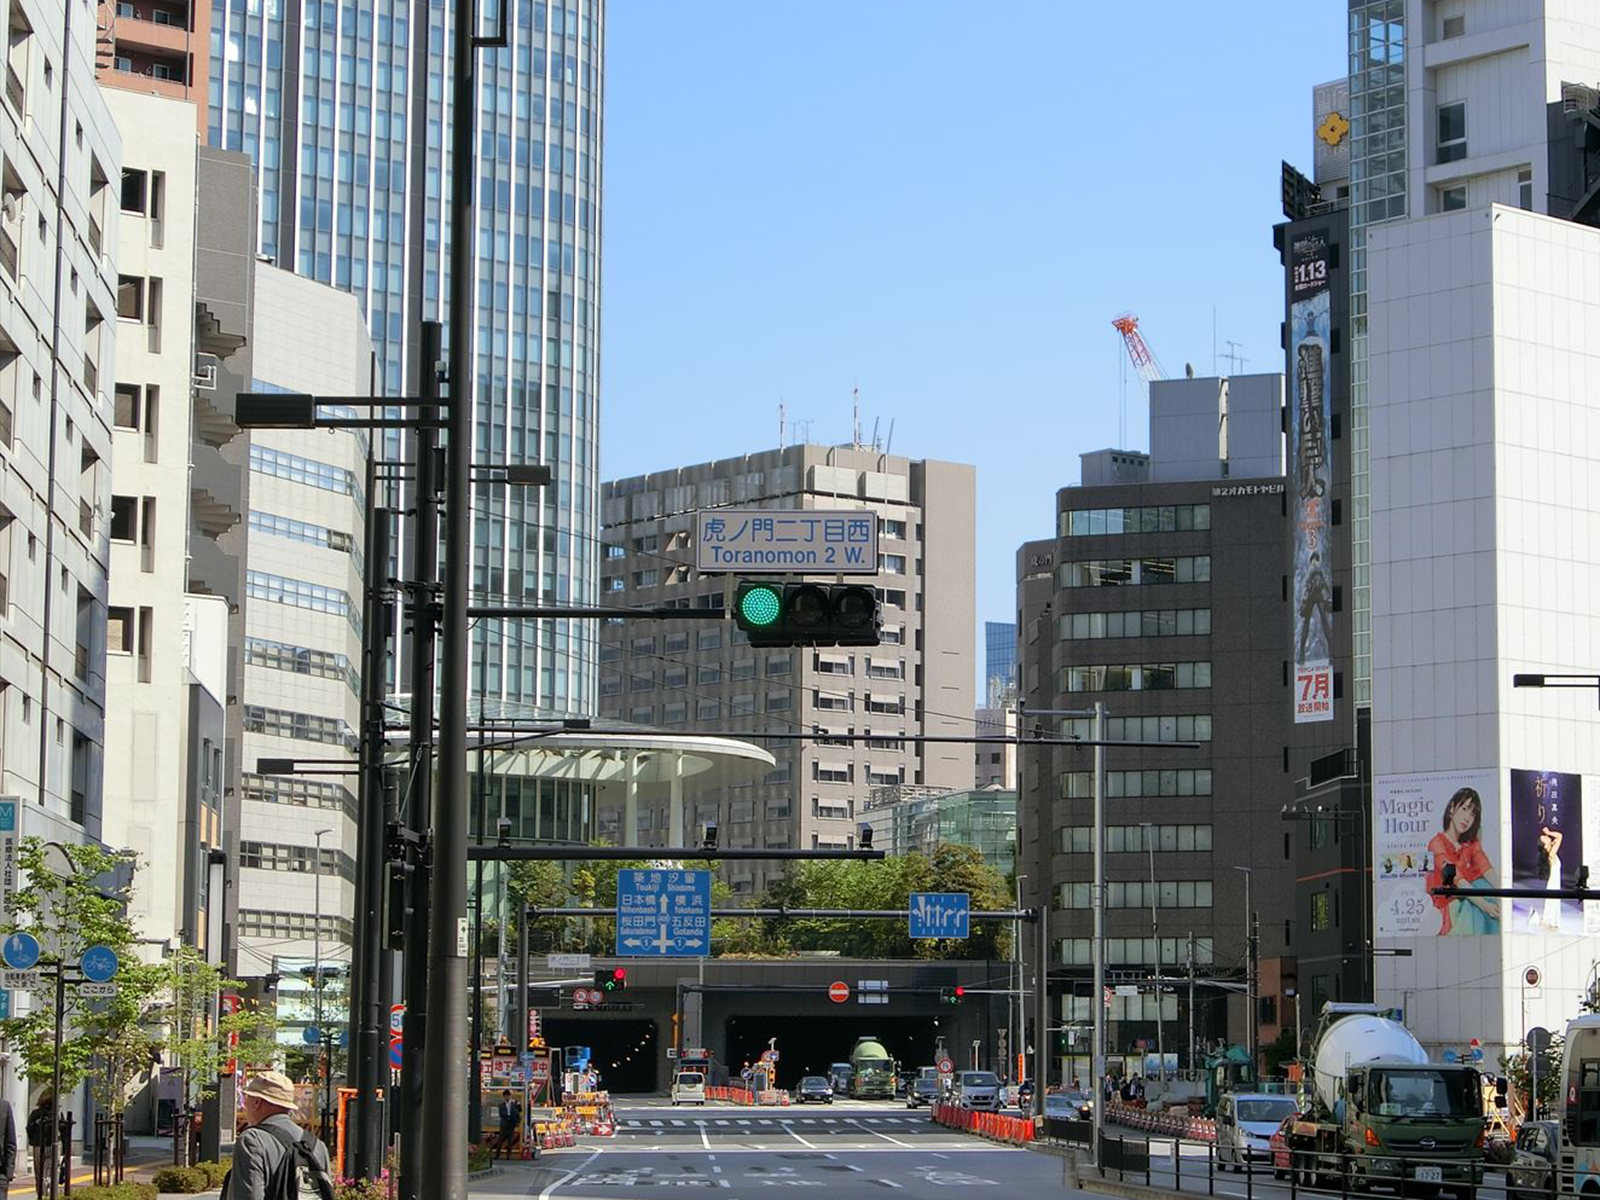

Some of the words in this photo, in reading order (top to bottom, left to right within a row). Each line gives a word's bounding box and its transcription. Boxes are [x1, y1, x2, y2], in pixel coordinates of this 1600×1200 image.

[1299, 260, 1326, 282] 1.13
[703, 518, 870, 542] 虎ノ門二丁目西
[711, 546, 816, 563] Toranomon
[825, 547, 835, 563] 2
[845, 547, 865, 563] W.
[1297, 673, 1329, 701] 7月
[1380, 797, 1434, 817] Magic
[1535, 776, 1547, 824] 祈り
[1384, 818, 1430, 834] Hour
[633, 872, 661, 883] 築地
[668, 872, 696, 884] 汐留
[636, 883, 660, 893] Tsukiji
[667, 884, 696, 892] Shiodome
[622, 894, 656, 905] 日本橋
[675, 895, 703, 906] 横浜
[1390, 898, 1425, 915] 4.25
[621, 916, 656, 927] 桜田門
[672, 916, 706, 927] 五反田
[673, 928, 704, 936] Gotanda
[83, 986, 115, 994] ここから
